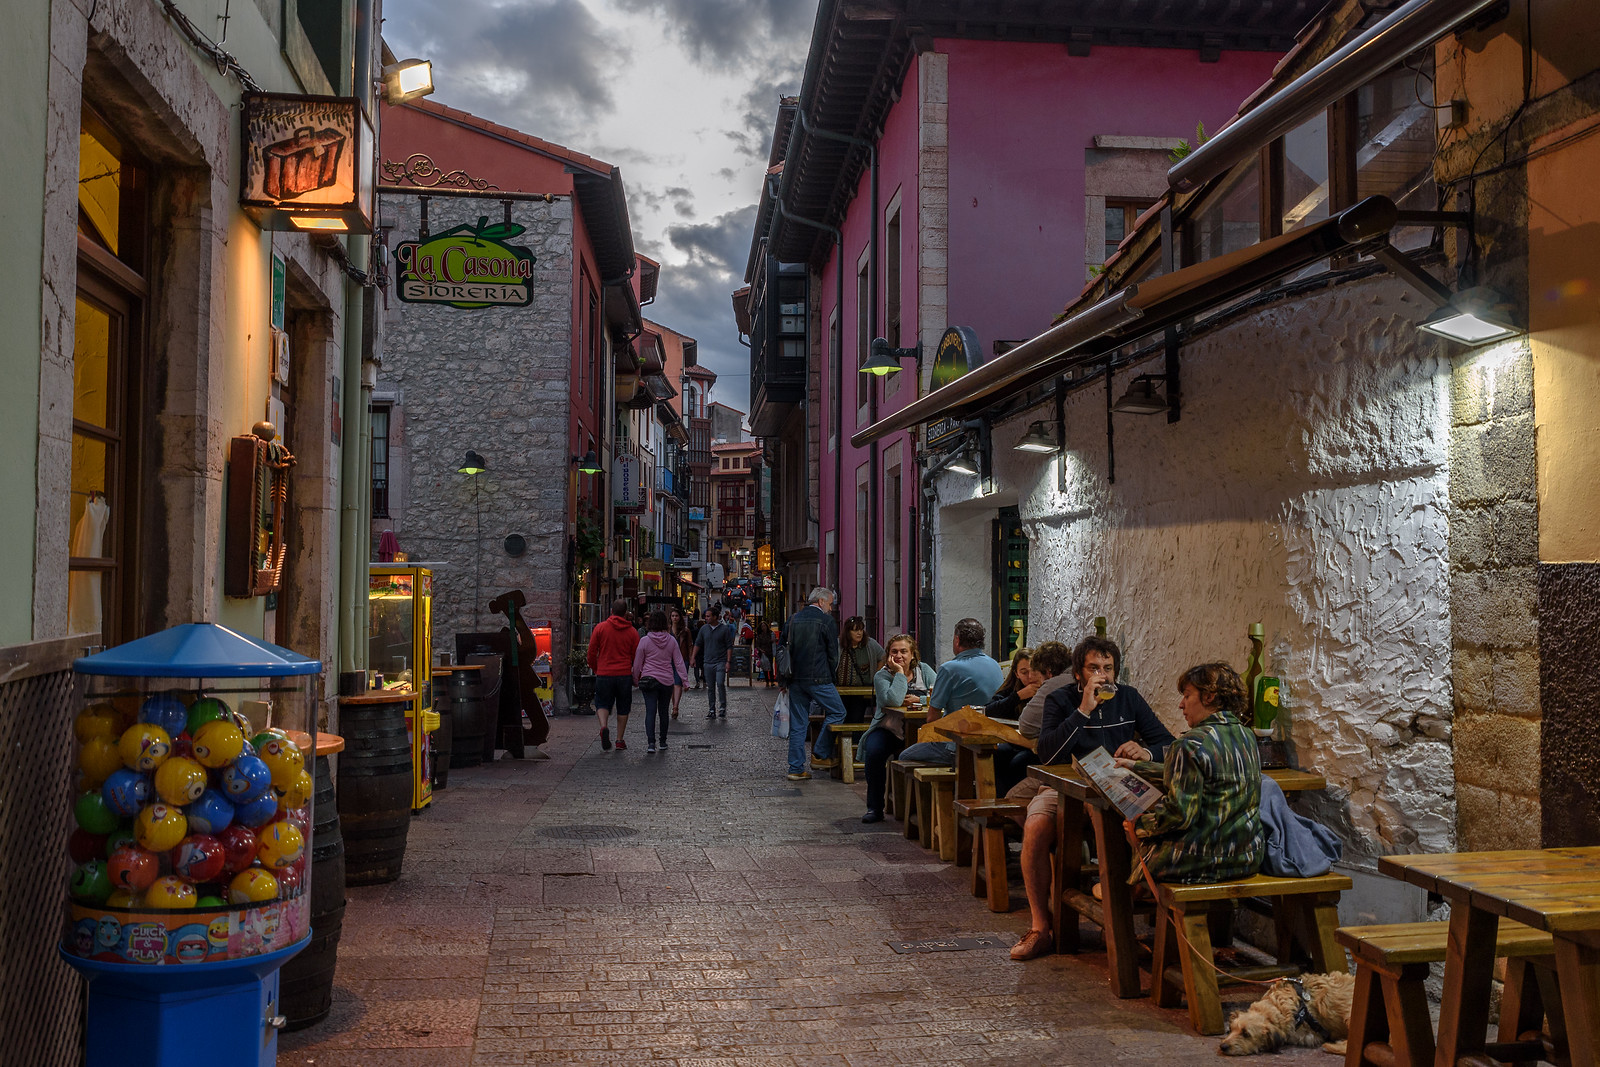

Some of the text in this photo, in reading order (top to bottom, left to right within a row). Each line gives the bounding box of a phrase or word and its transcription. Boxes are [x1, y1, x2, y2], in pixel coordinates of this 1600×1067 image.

[397, 243, 533, 284] La Casona
[131, 927, 167, 937] CLICK
[143, 938, 152, 948] &
[132, 949, 163, 959] PLAY
